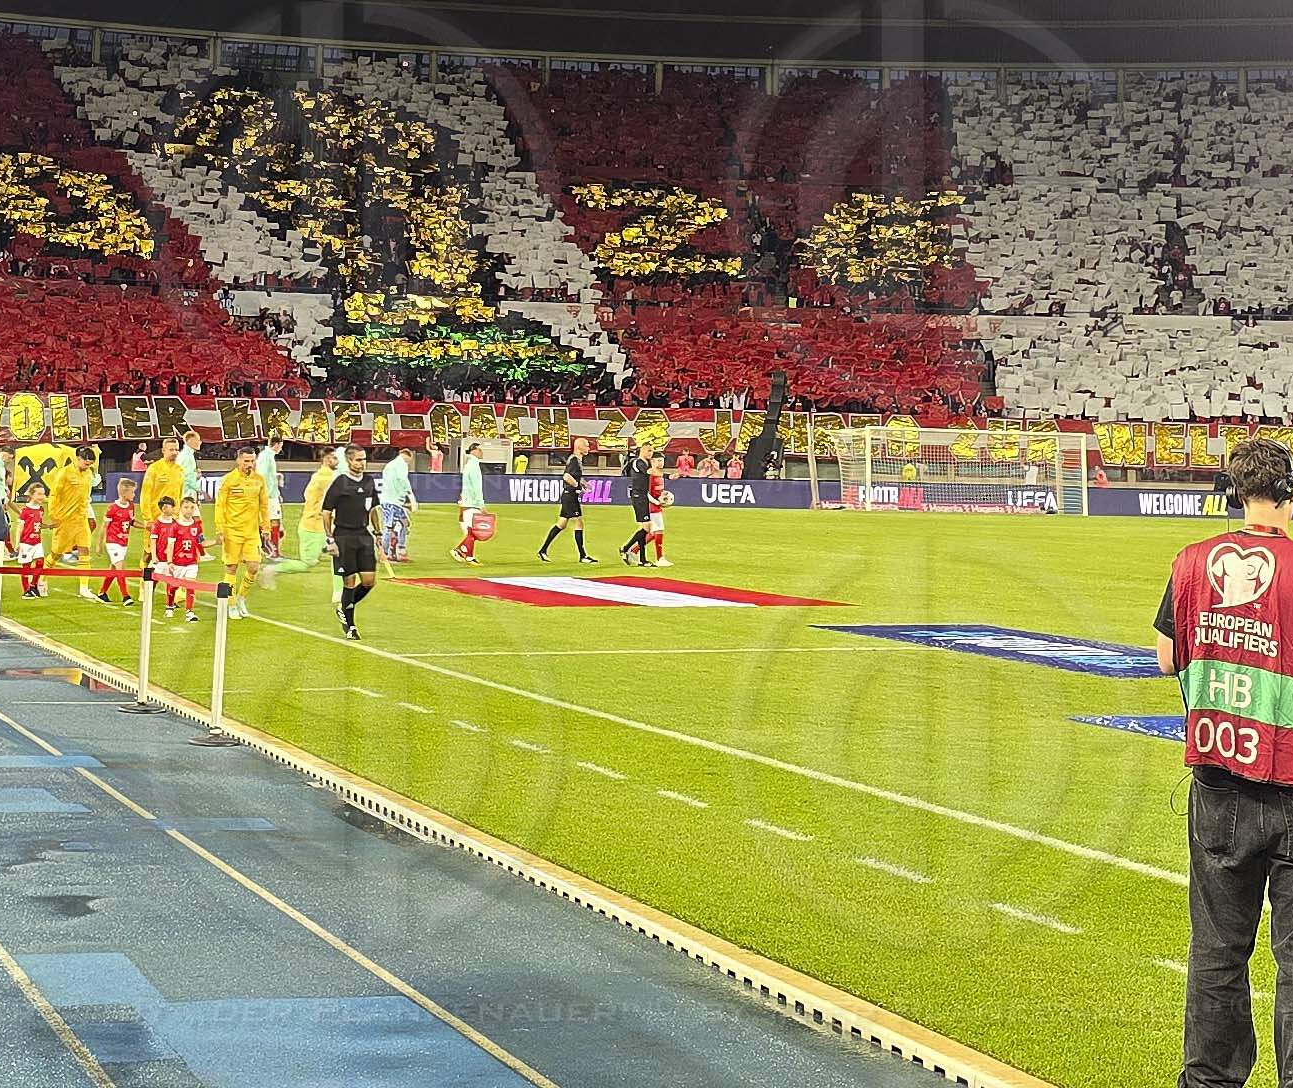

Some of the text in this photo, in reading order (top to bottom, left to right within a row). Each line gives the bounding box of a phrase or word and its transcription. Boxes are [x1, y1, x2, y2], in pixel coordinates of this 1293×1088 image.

[215, 398, 394, 444] KRAFT
[429, 403, 569, 448] NACH
[596, 408, 670, 452] 28
[510, 479, 563, 502] WELCO
[701, 484, 755, 504] UEFA
[1139, 493, 1228, 516] WELCOME ALL
[1199, 612, 1272, 638] EUROPEAN
[1195, 627, 1278, 657] QUALIFIERS
[1209, 669, 1252, 708] HB
[1195, 717, 1259, 764] 003
